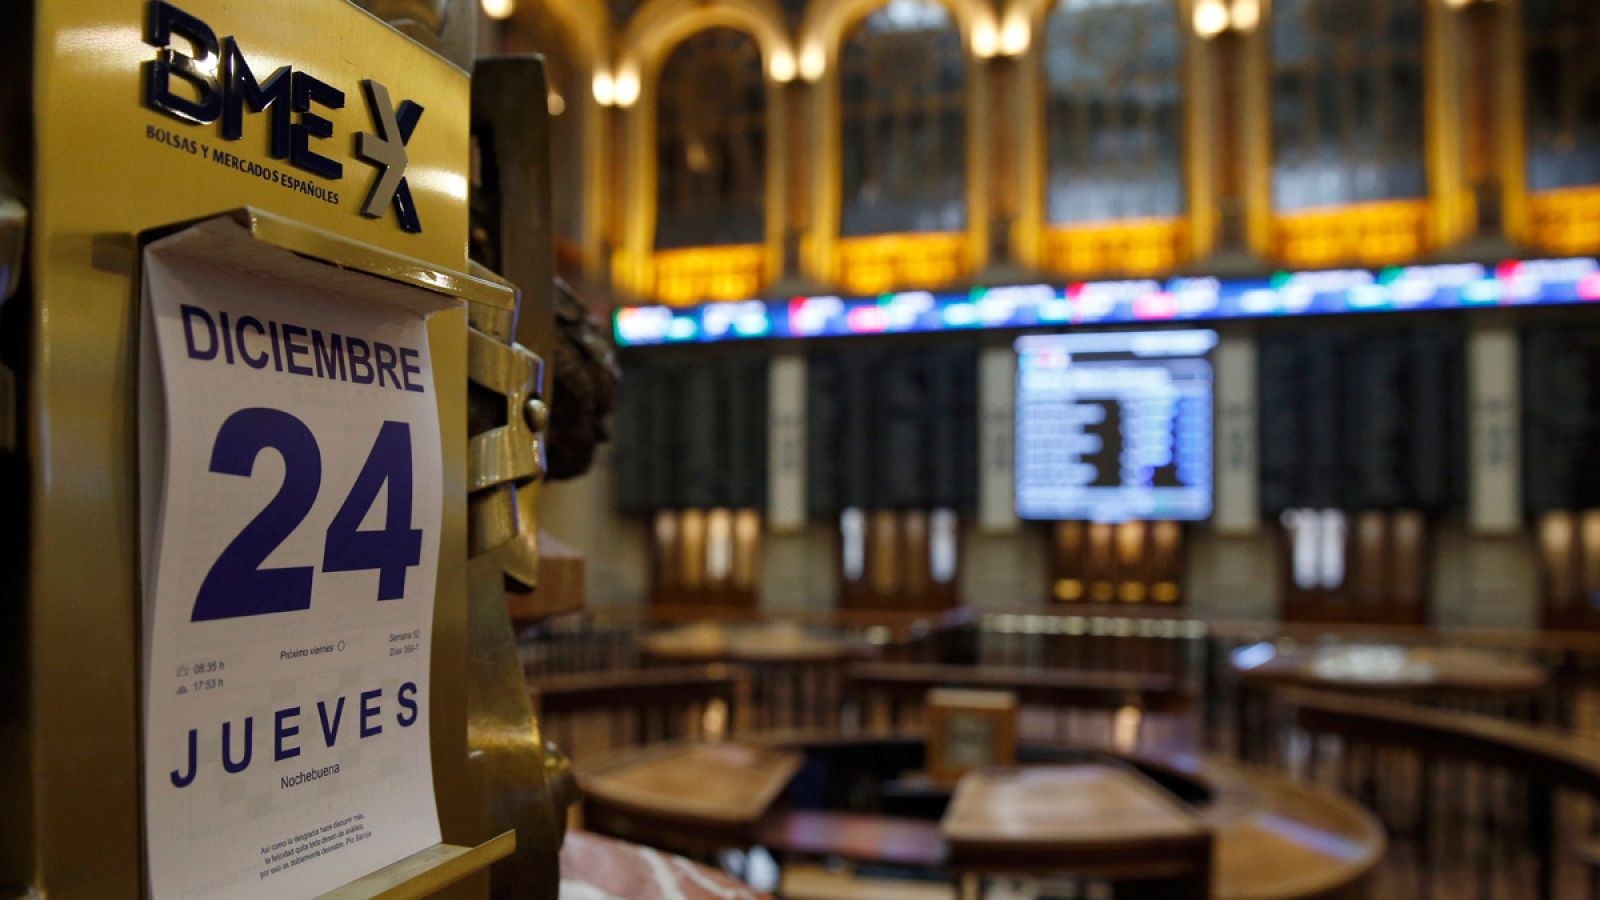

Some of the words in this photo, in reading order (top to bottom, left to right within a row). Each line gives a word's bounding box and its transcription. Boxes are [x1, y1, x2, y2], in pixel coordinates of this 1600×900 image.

[146, 125, 197, 154] BOLSAS
[201, 144, 209, 159] Y
[212, 148, 280, 183] MERCADOS
[281, 173, 340, 205] ESPAÑOLES
[180, 304, 425, 393] DICIEMBRE
[190, 407, 423, 622] 24
[170, 682, 418, 788] JUEVES
[280, 763, 340, 789] Nochebuena
